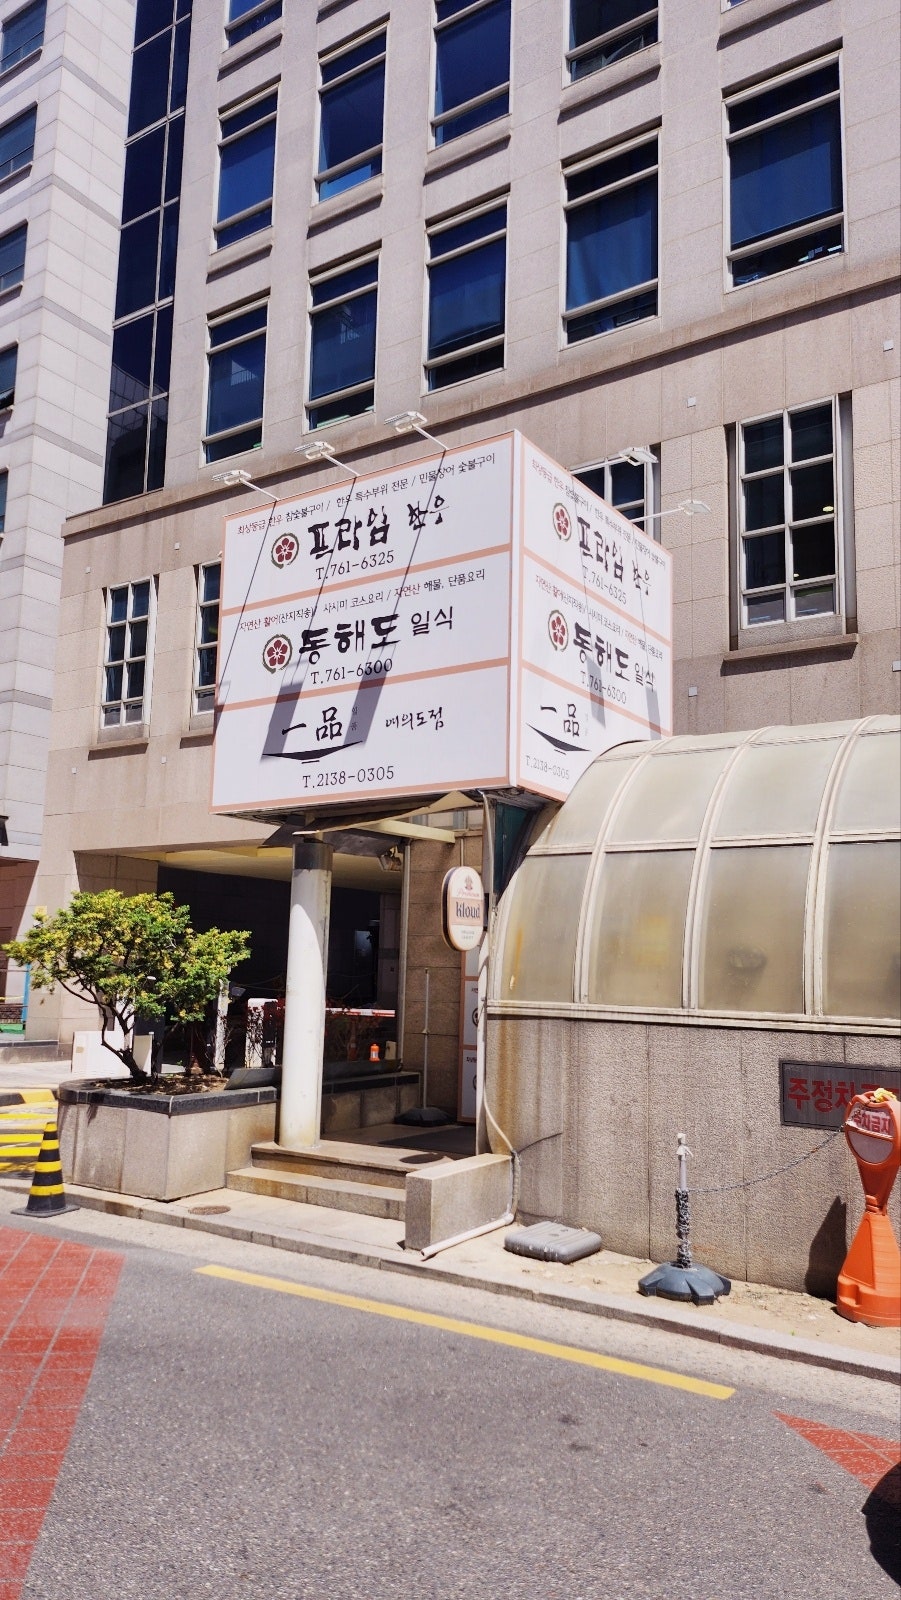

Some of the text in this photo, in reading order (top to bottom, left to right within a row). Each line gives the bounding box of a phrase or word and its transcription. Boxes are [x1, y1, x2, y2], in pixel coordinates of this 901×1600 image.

[336, 494, 352, 508] 한우
[355, 484, 388, 502] 특수부위
[391, 478, 409, 493] 전문
[419, 464, 455, 484] 민물장어
[458, 453, 496, 474] 숯불구이
[308, 495, 450, 560] 프라임 한우
[577, 516, 624, 583] 프라임
[315, 549, 395, 581] T.761-6325
[323, 599, 348, 613] 사시미
[350, 591, 384, 608] 코스요리
[394, 583, 421, 598] 자연산
[448, 568, 486, 587] 단품요리
[299, 606, 453, 665] 동해도 일식
[573, 621, 656, 693] 동해도 일식
[310, 658, 393, 685] T.761-6300
[580, 670, 627, 705] T.761-6300
[302, 765, 395, 789] T.2138-0305
